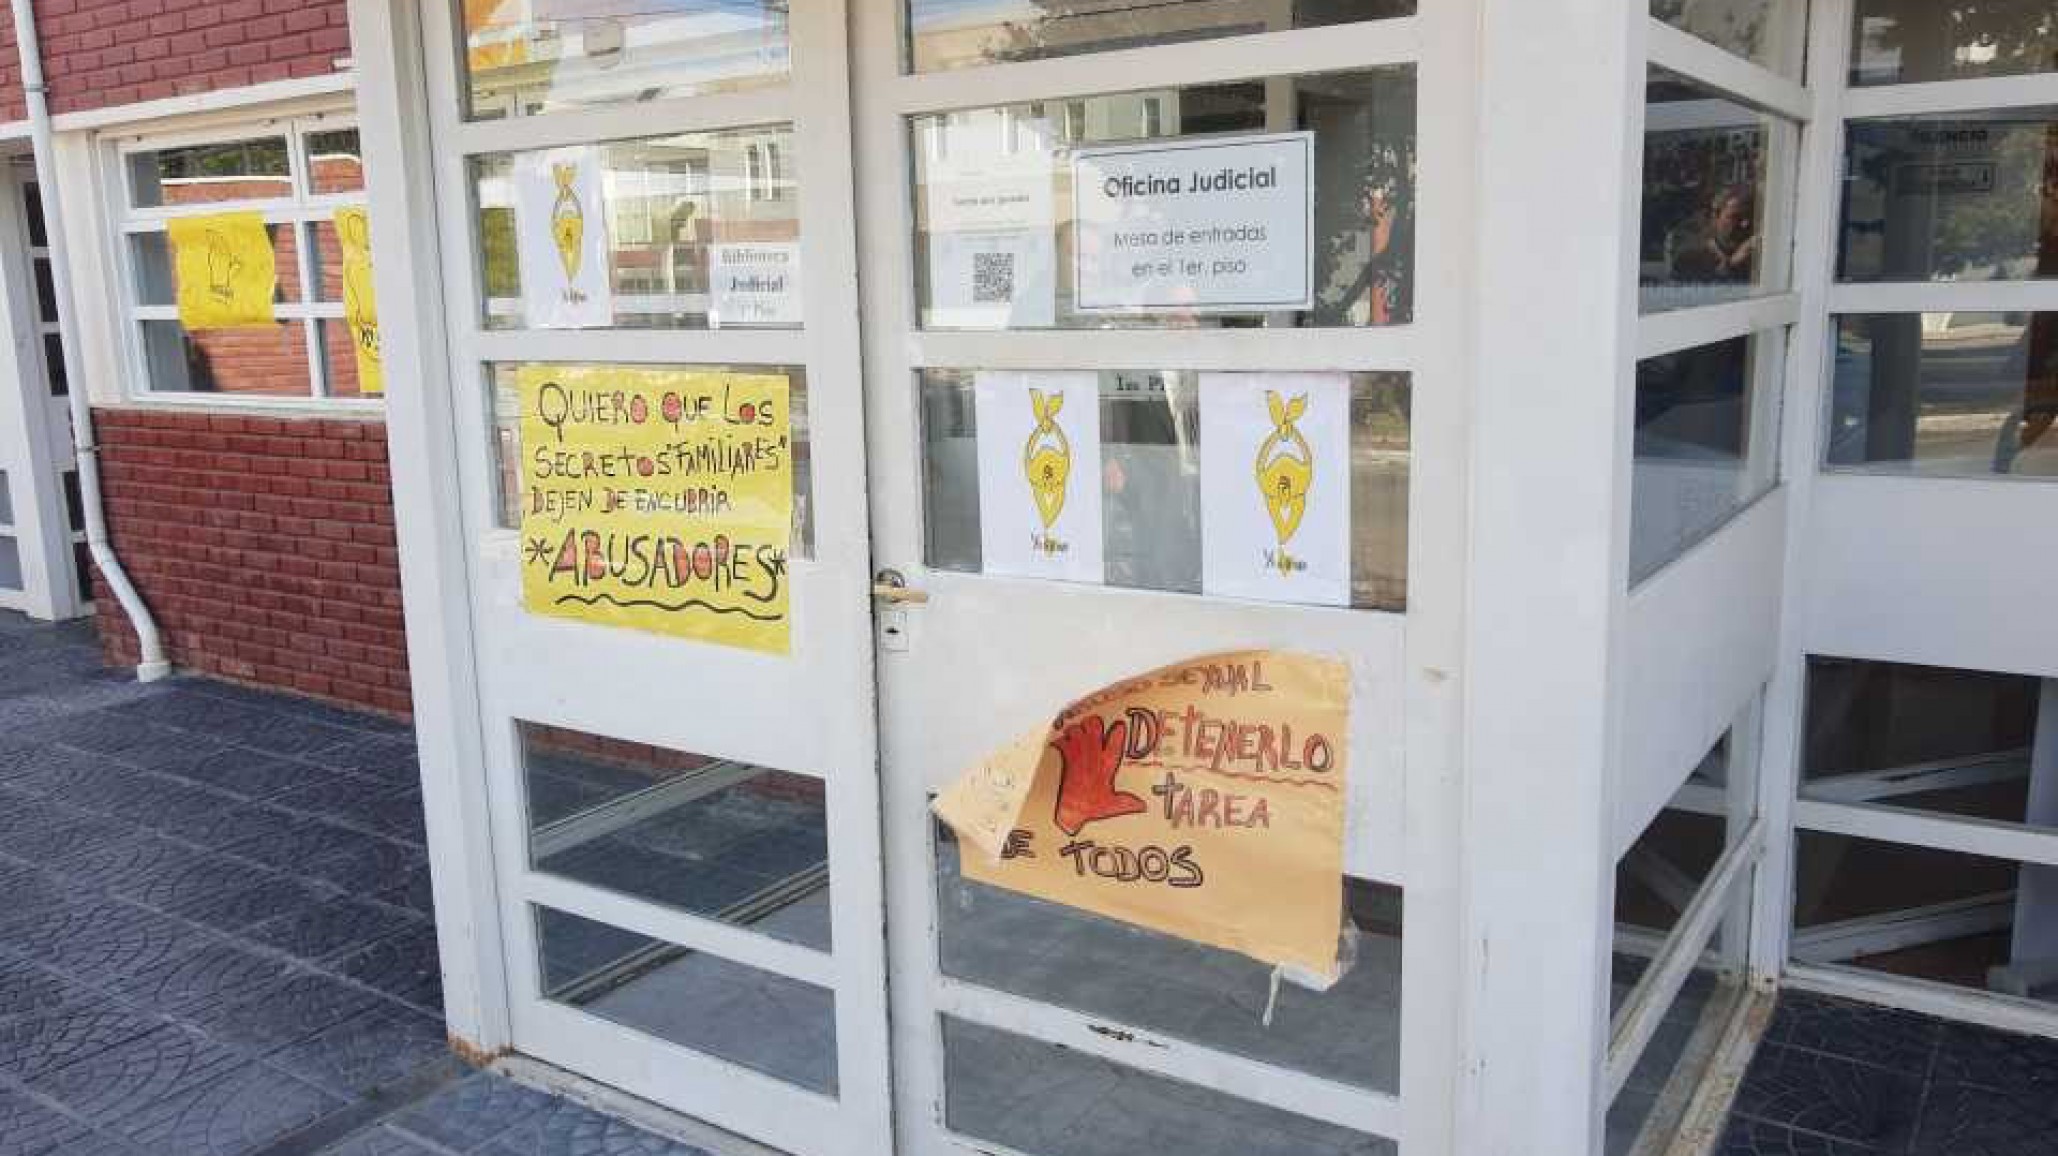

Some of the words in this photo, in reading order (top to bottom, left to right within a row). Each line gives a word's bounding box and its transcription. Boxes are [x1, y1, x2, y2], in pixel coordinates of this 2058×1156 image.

[1103, 174, 1180, 198] Oficina
[1189, 166, 1277, 194] Judicial
[1114, 230, 1159, 248] Mesa
[1162, 226, 1185, 246] de
[1188, 223, 1268, 245] entradas
[1212, 258, 1247, 278] piso
[730, 275, 784, 294] Judicial
[538, 381, 649, 443] QUIERO
[660, 390, 712, 434] QUE
[600, 486, 628, 514] DE
[1059, 839, 1205, 889] TODOS
